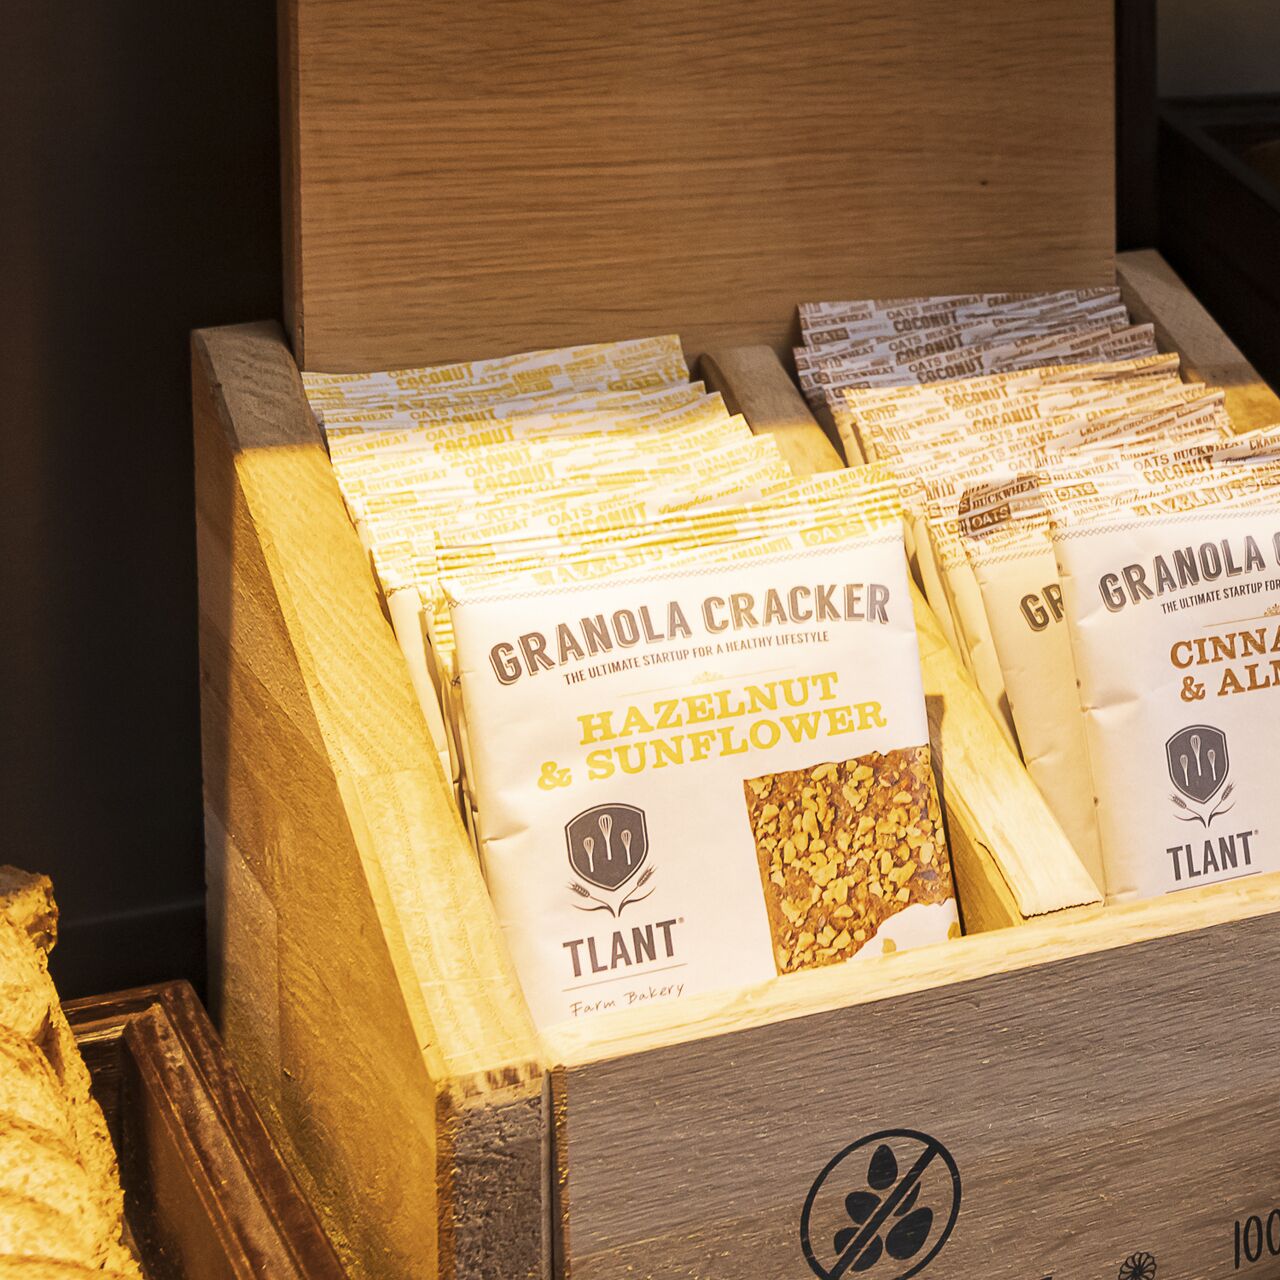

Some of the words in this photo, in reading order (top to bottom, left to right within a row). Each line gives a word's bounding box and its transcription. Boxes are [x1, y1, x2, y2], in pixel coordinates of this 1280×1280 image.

[396, 362, 474, 391] COCONUT
[1133, 454, 1169, 471] OATS
[1143, 455, 1215, 486] COCONUT
[1098, 535, 1266, 613] GRANOLA
[1160, 600, 1178, 615] THE
[1179, 589, 1222, 609] ULTIMATE
[1223, 582, 1263, 599] STARTUP
[488, 600, 692, 686] GRANOLA
[701, 583, 891, 635] CRACKER
[563, 670, 587, 687] THE
[588, 656, 641, 683] ULTIMATE
[642, 648, 691, 668] STARTUP
[692, 645, 713, 660] FOR
[715, 643, 725, 656] A
[725, 634, 774, 655] HEALTHY
[775, 630, 830, 647] LIFESTYLE
[576, 671, 839, 747] HAZELNUT
[1180, 676, 1206, 703] &
[537, 760, 573, 791] &
[587, 700, 888, 783] SUNFLOWER
[1166, 830, 1253, 881] TLANT
[562, 918, 678, 978] TLANT
[571, 996, 617, 1017] Farm
[624, 981, 684, 1007] Bakery
